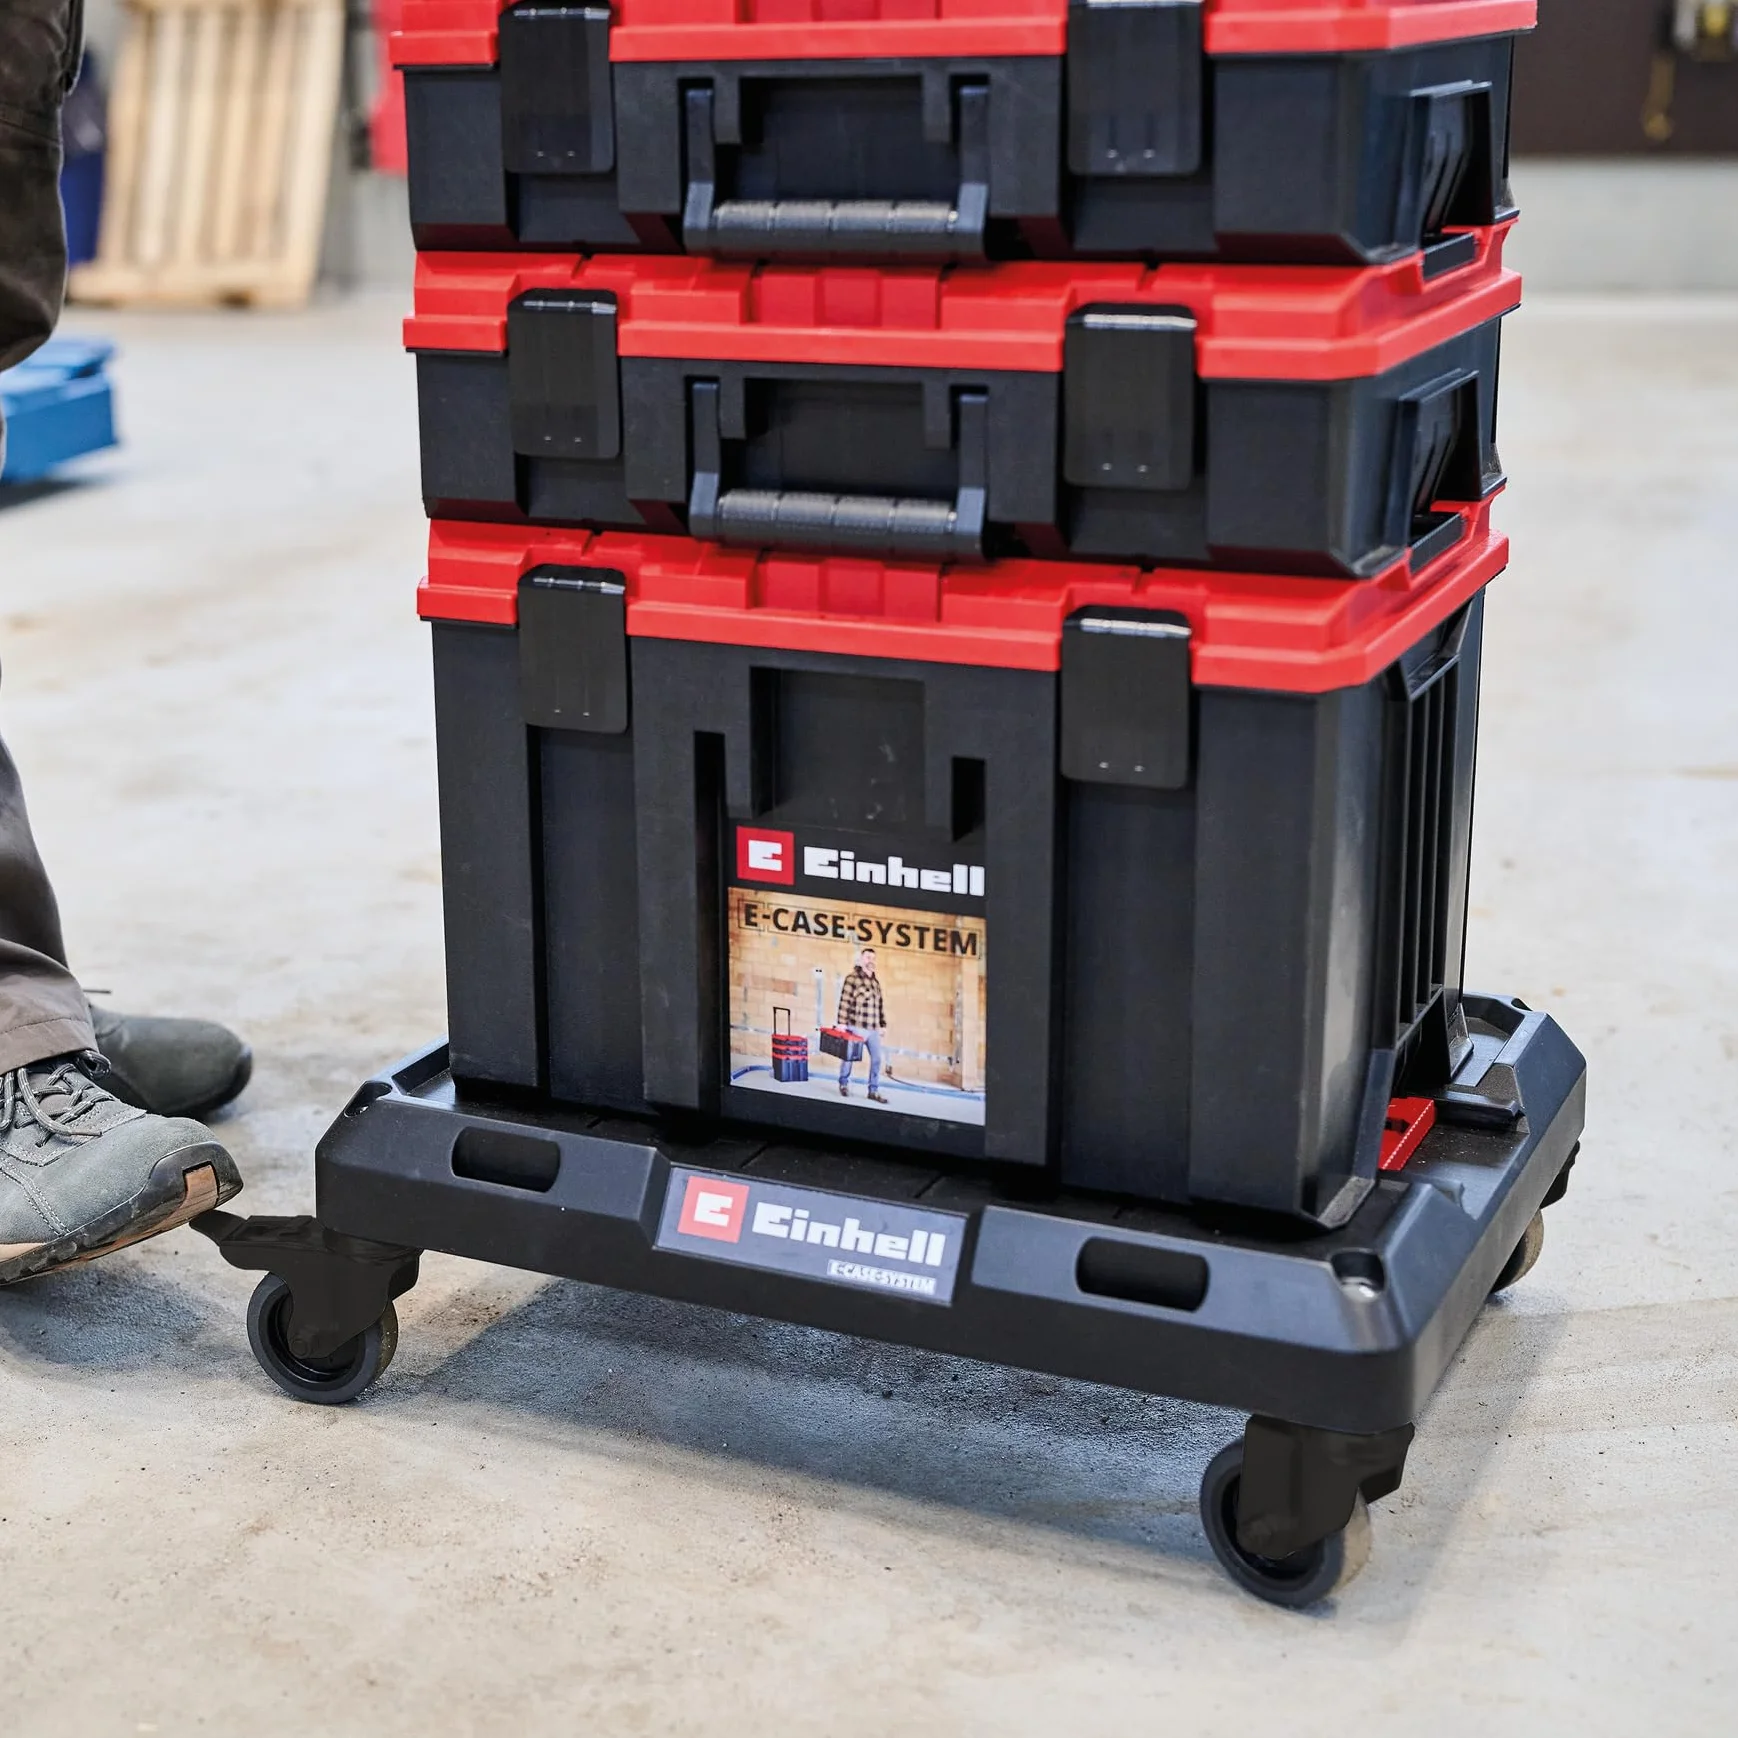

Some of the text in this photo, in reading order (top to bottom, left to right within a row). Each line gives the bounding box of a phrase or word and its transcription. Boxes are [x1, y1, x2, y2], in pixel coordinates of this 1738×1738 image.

[803, 846, 985, 896] Einhell
[744, 903, 978, 956] E-CASE-SYSTEM
[752, 1201, 946, 1267] Einhell
